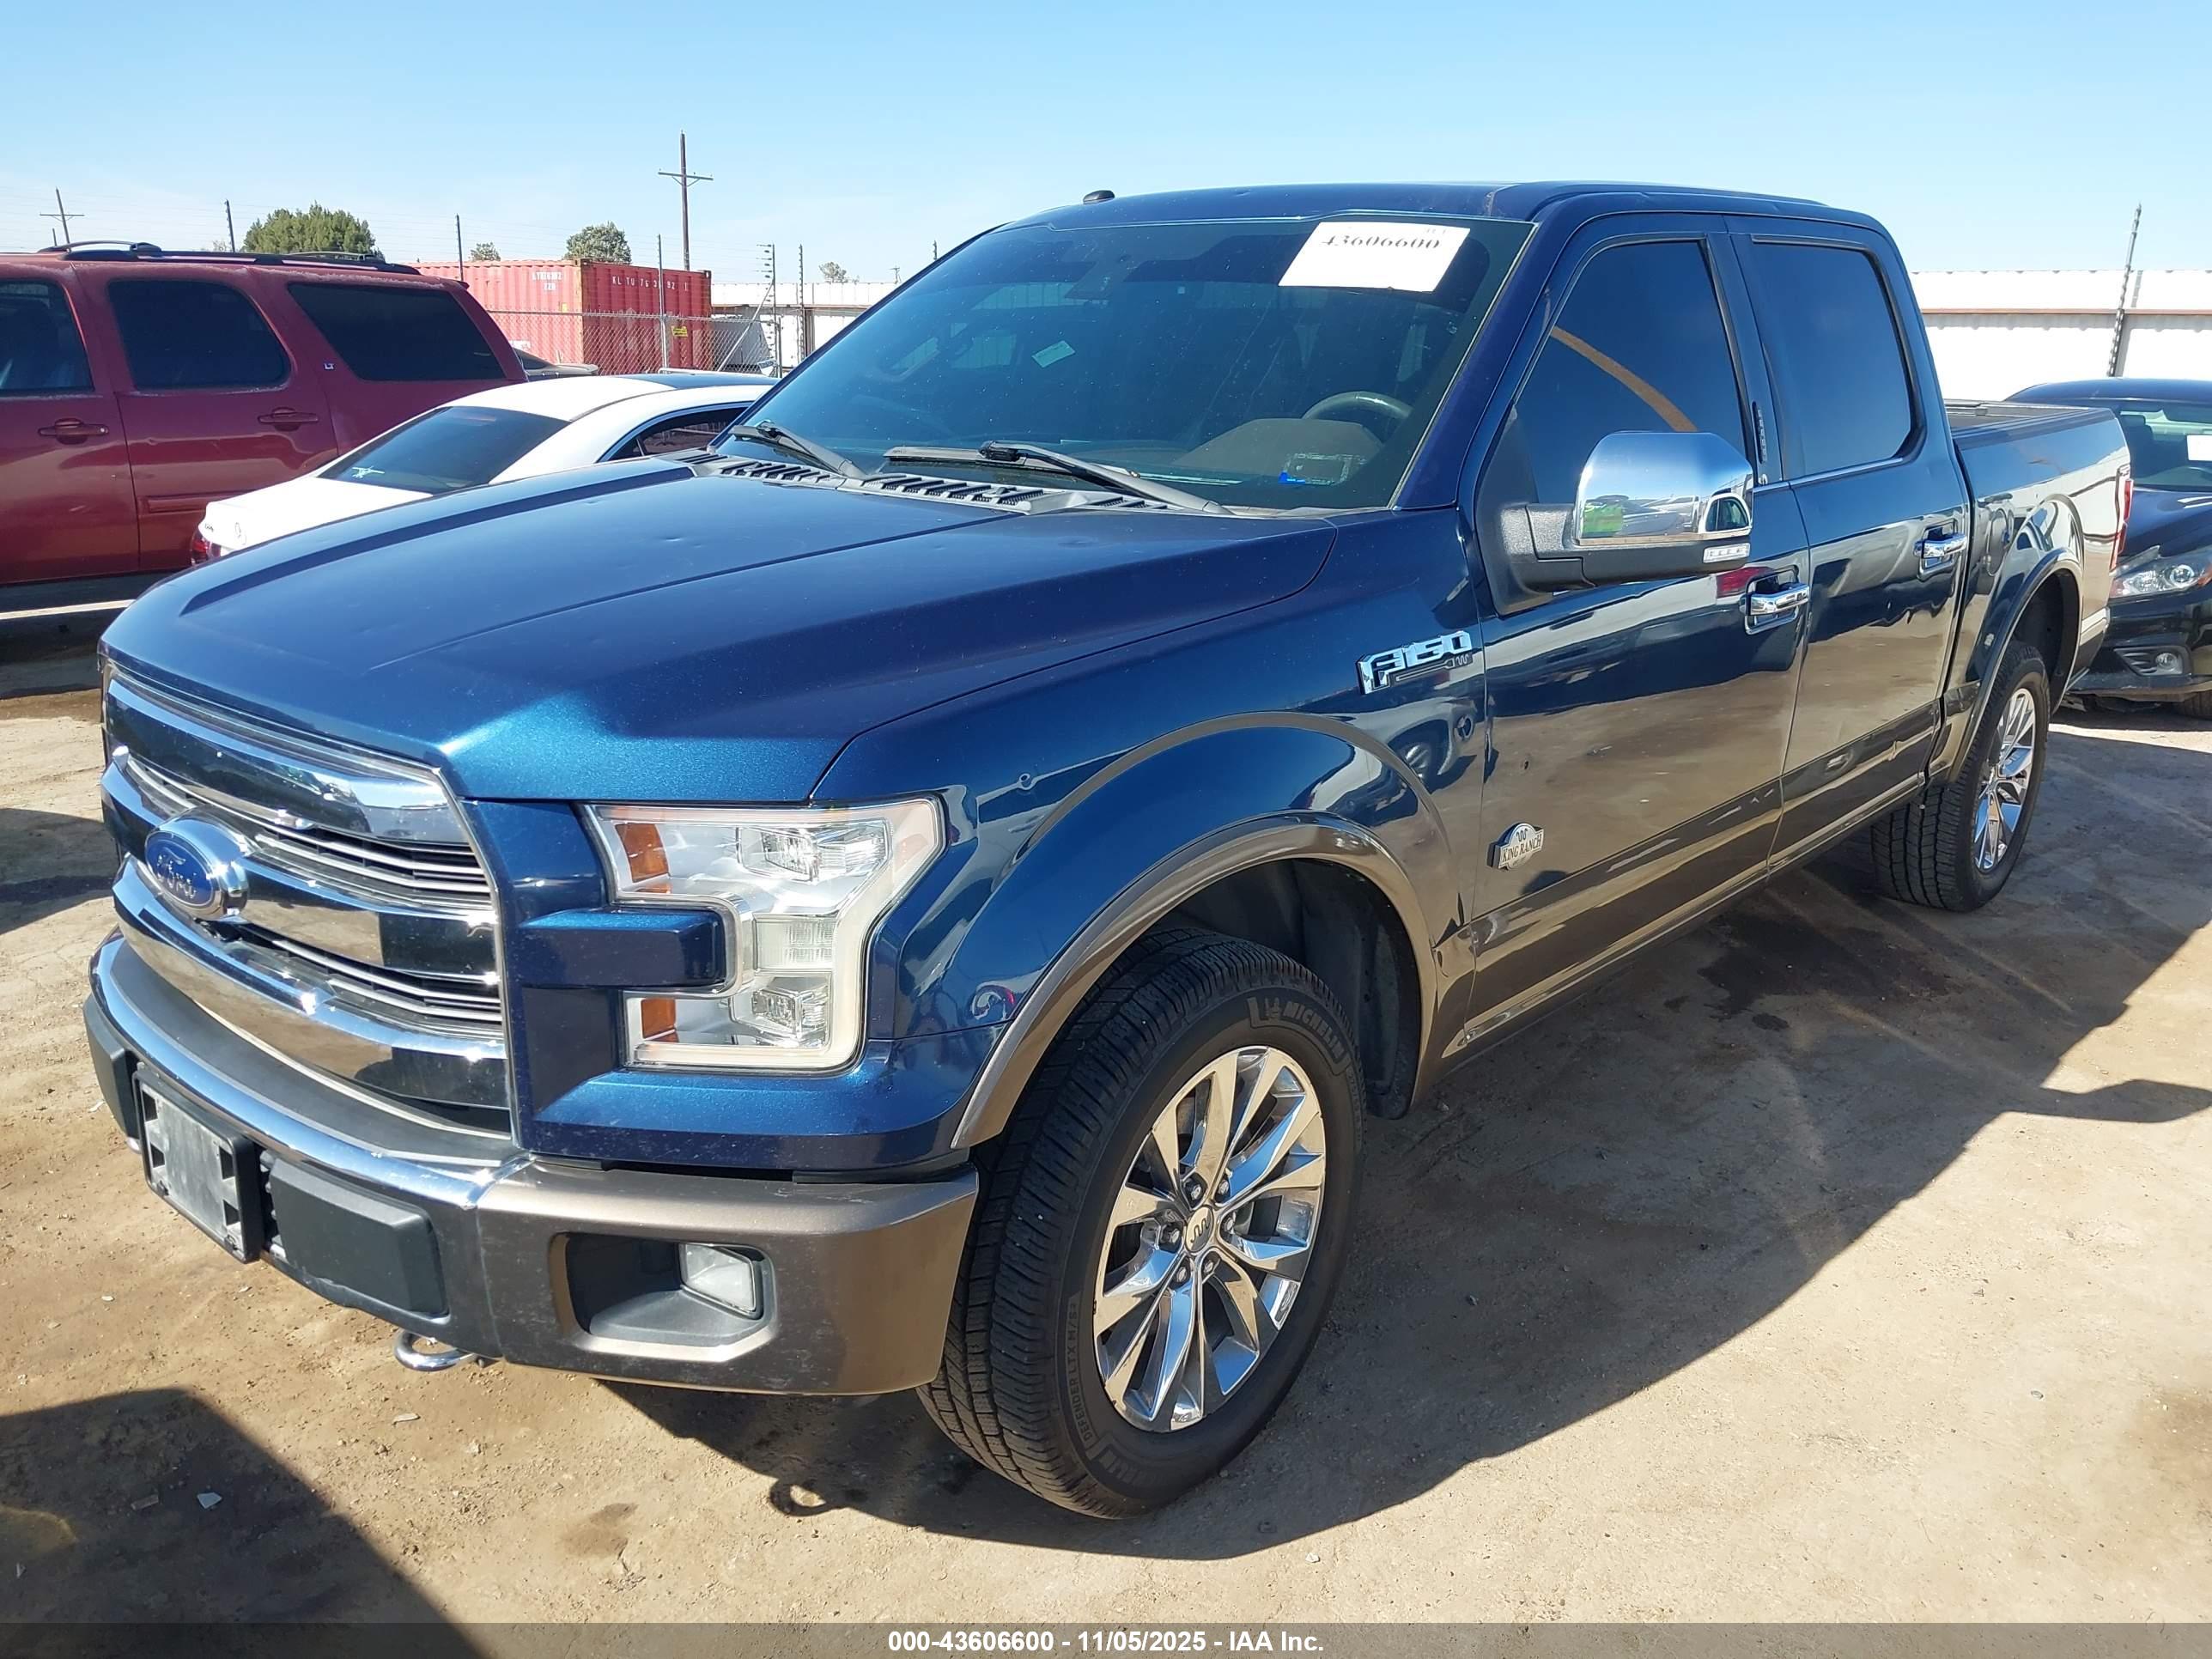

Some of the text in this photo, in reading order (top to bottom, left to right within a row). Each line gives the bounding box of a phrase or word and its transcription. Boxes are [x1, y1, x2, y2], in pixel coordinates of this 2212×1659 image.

[1322, 234, 1441, 249] 43606600
[1502, 845, 1519, 863] KING
[1519, 833, 1542, 855] RANCH
[1282, 1000, 1346, 1061] MICHELIN
[1066, 1345, 1079, 1374] LTX
[1068, 1377, 1093, 1442] DEFENDER
